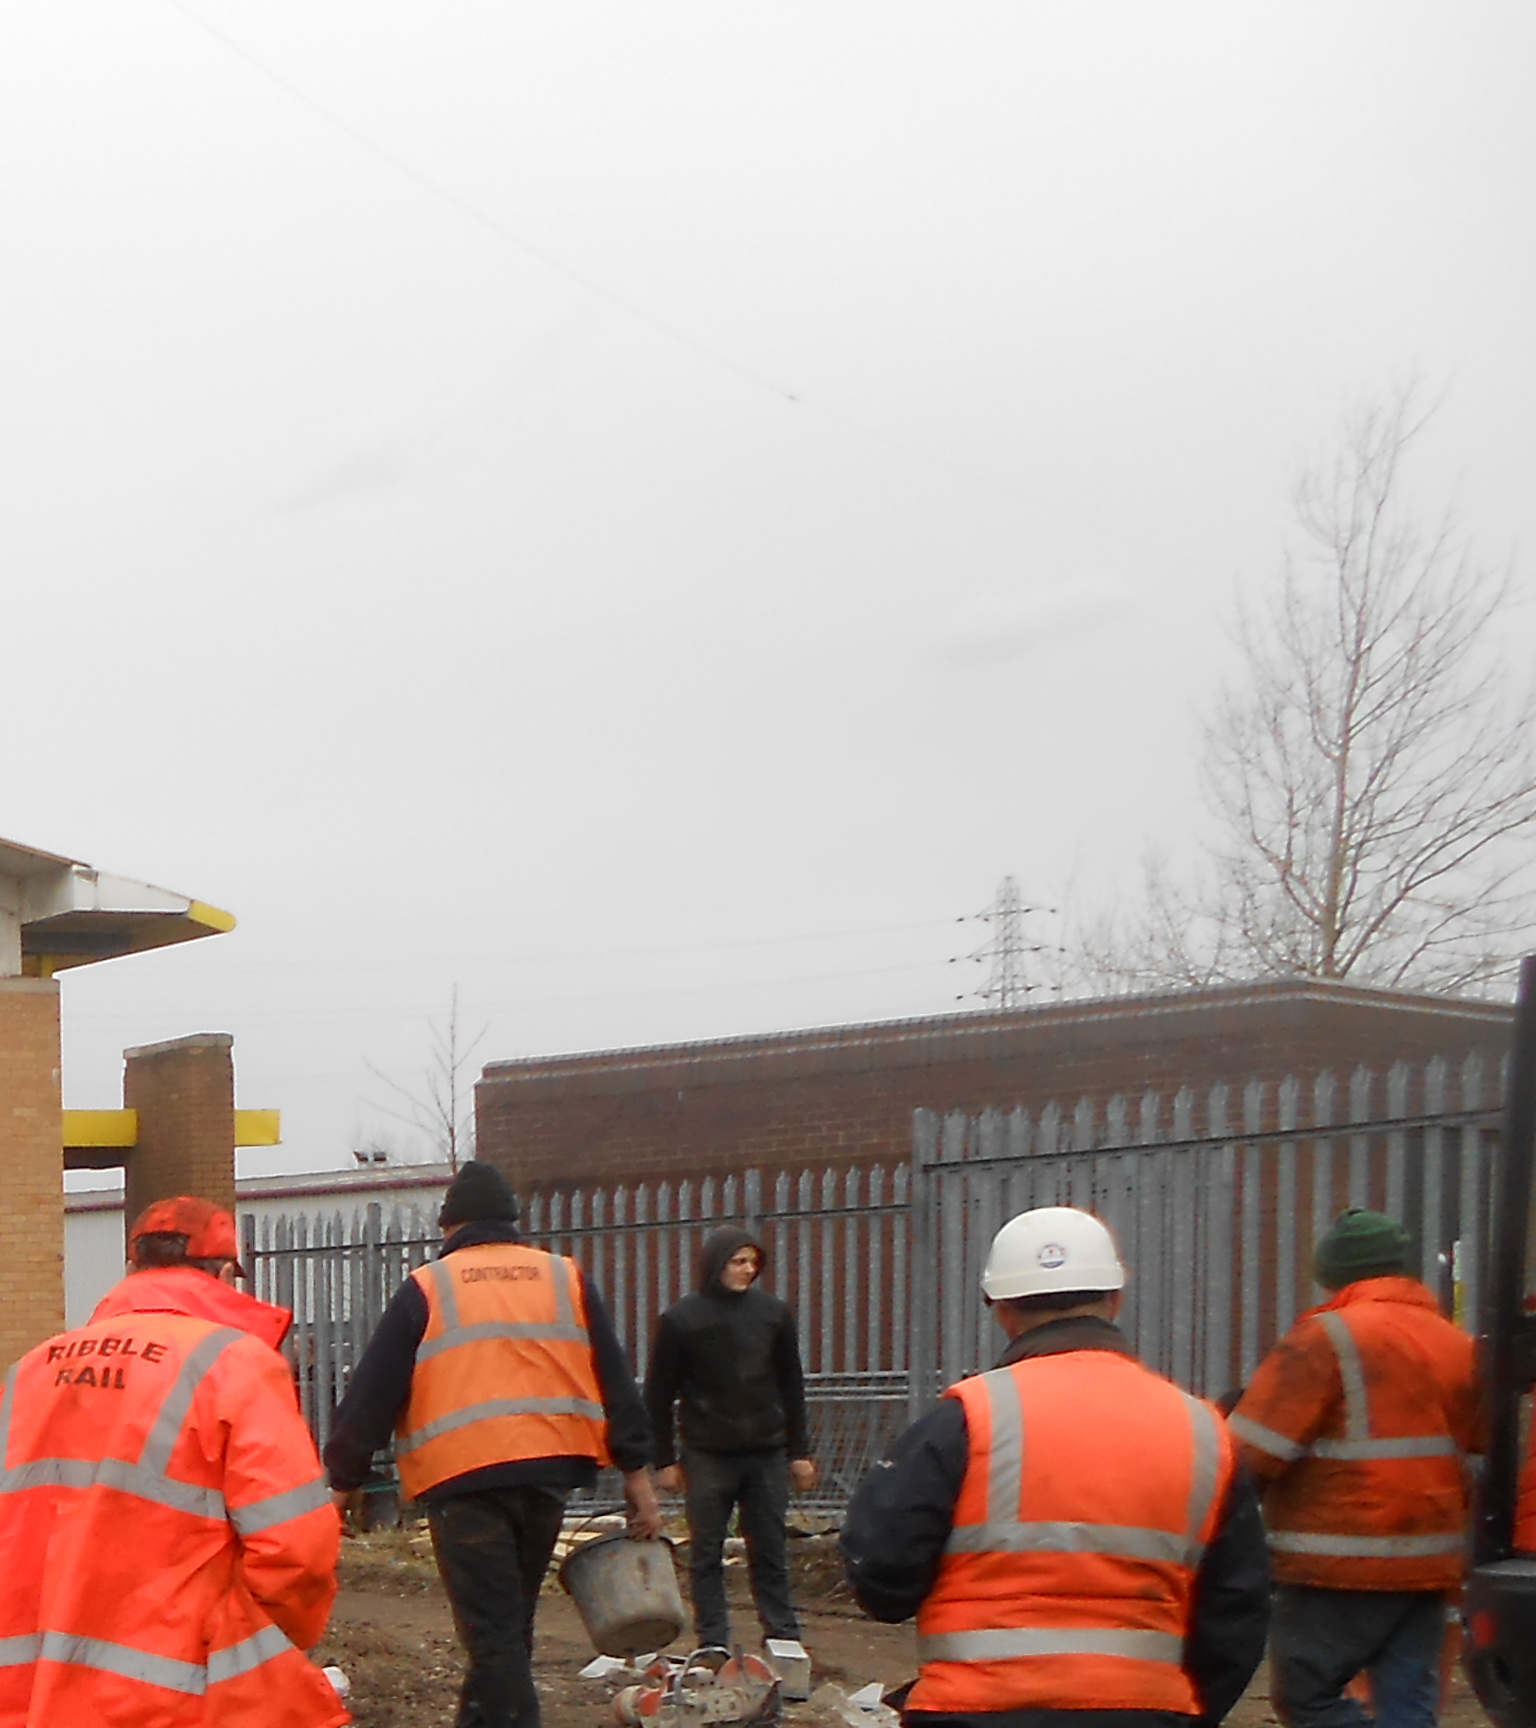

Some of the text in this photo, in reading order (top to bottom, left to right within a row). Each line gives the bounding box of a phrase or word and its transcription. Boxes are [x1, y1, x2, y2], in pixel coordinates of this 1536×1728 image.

[461, 1265, 542, 1284] CONTRACTOR
[47, 1337, 169, 1365] RIBBLE
[54, 1366, 126, 1390] RAIL
